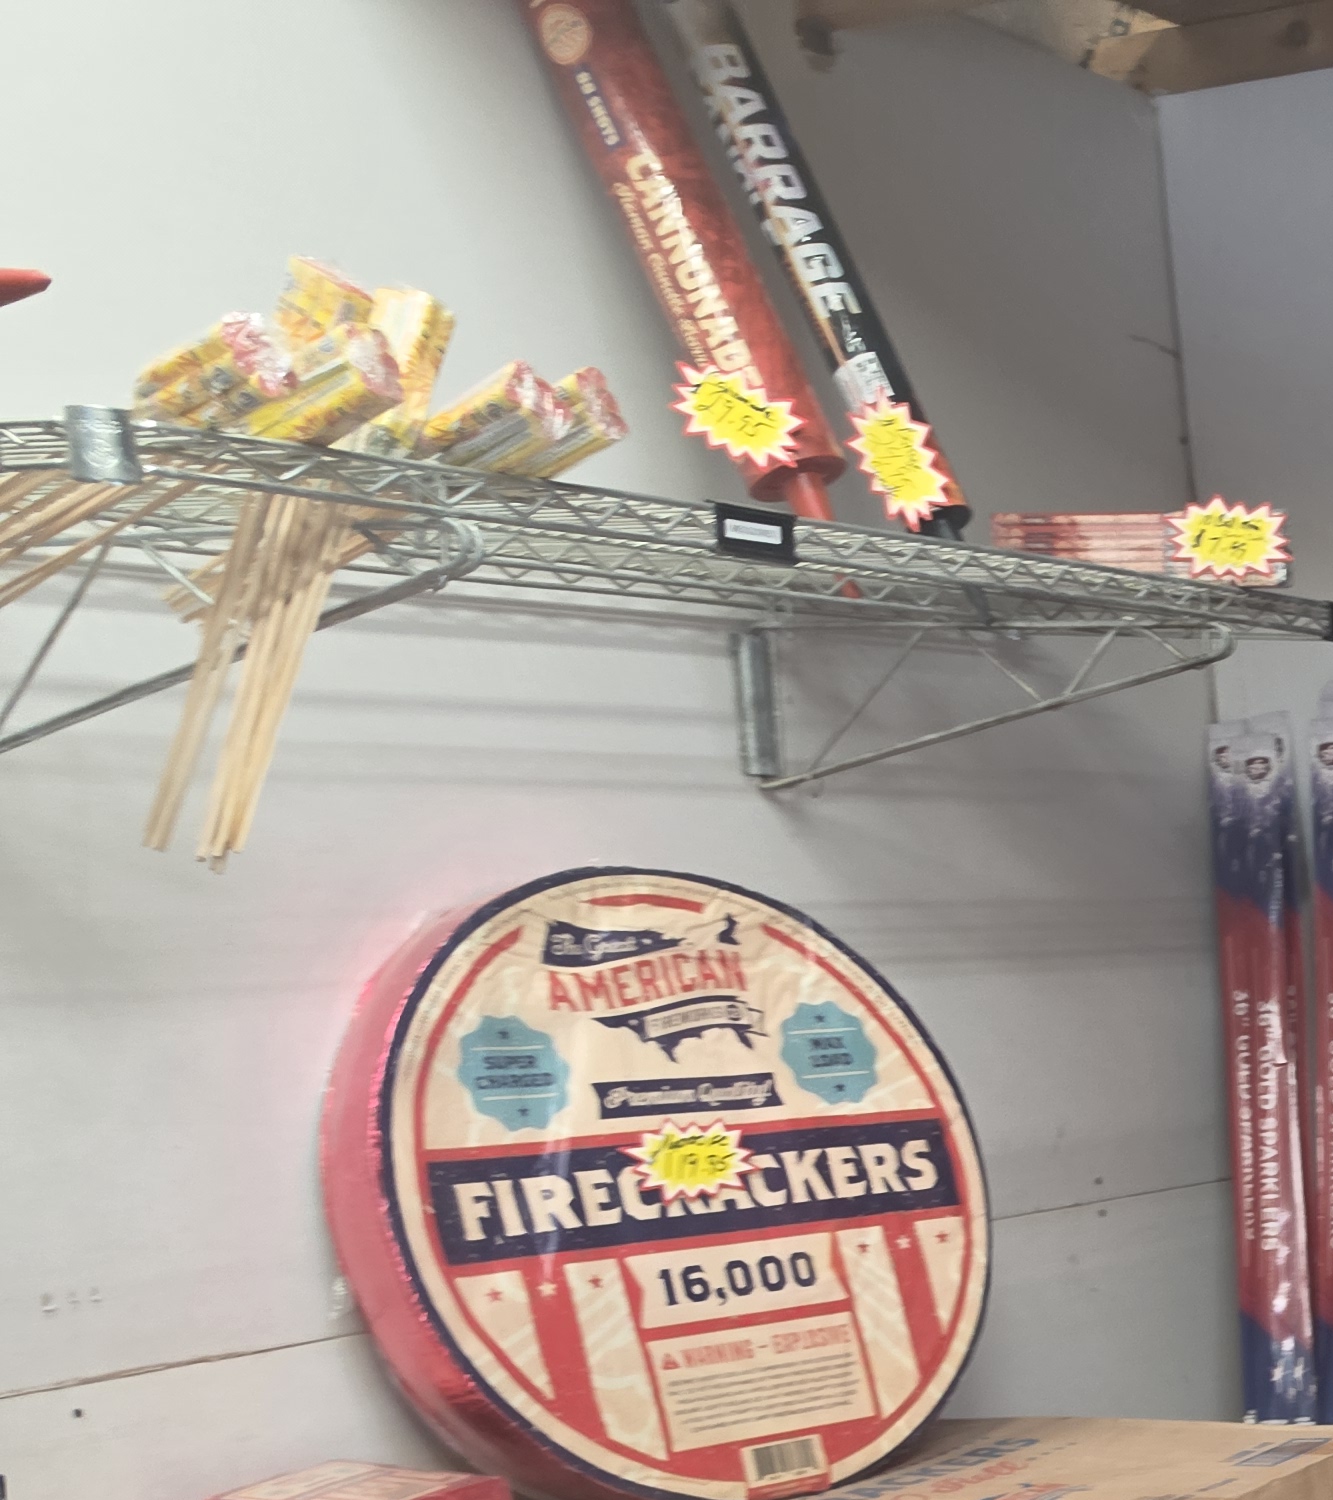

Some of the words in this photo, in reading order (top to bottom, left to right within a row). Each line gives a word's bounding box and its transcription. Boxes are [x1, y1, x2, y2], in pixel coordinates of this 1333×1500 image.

[699, 43, 863, 319] BARRAGE
[549, 949, 749, 1012] AMERICAN
[658, 1251, 820, 1307] 16,000
